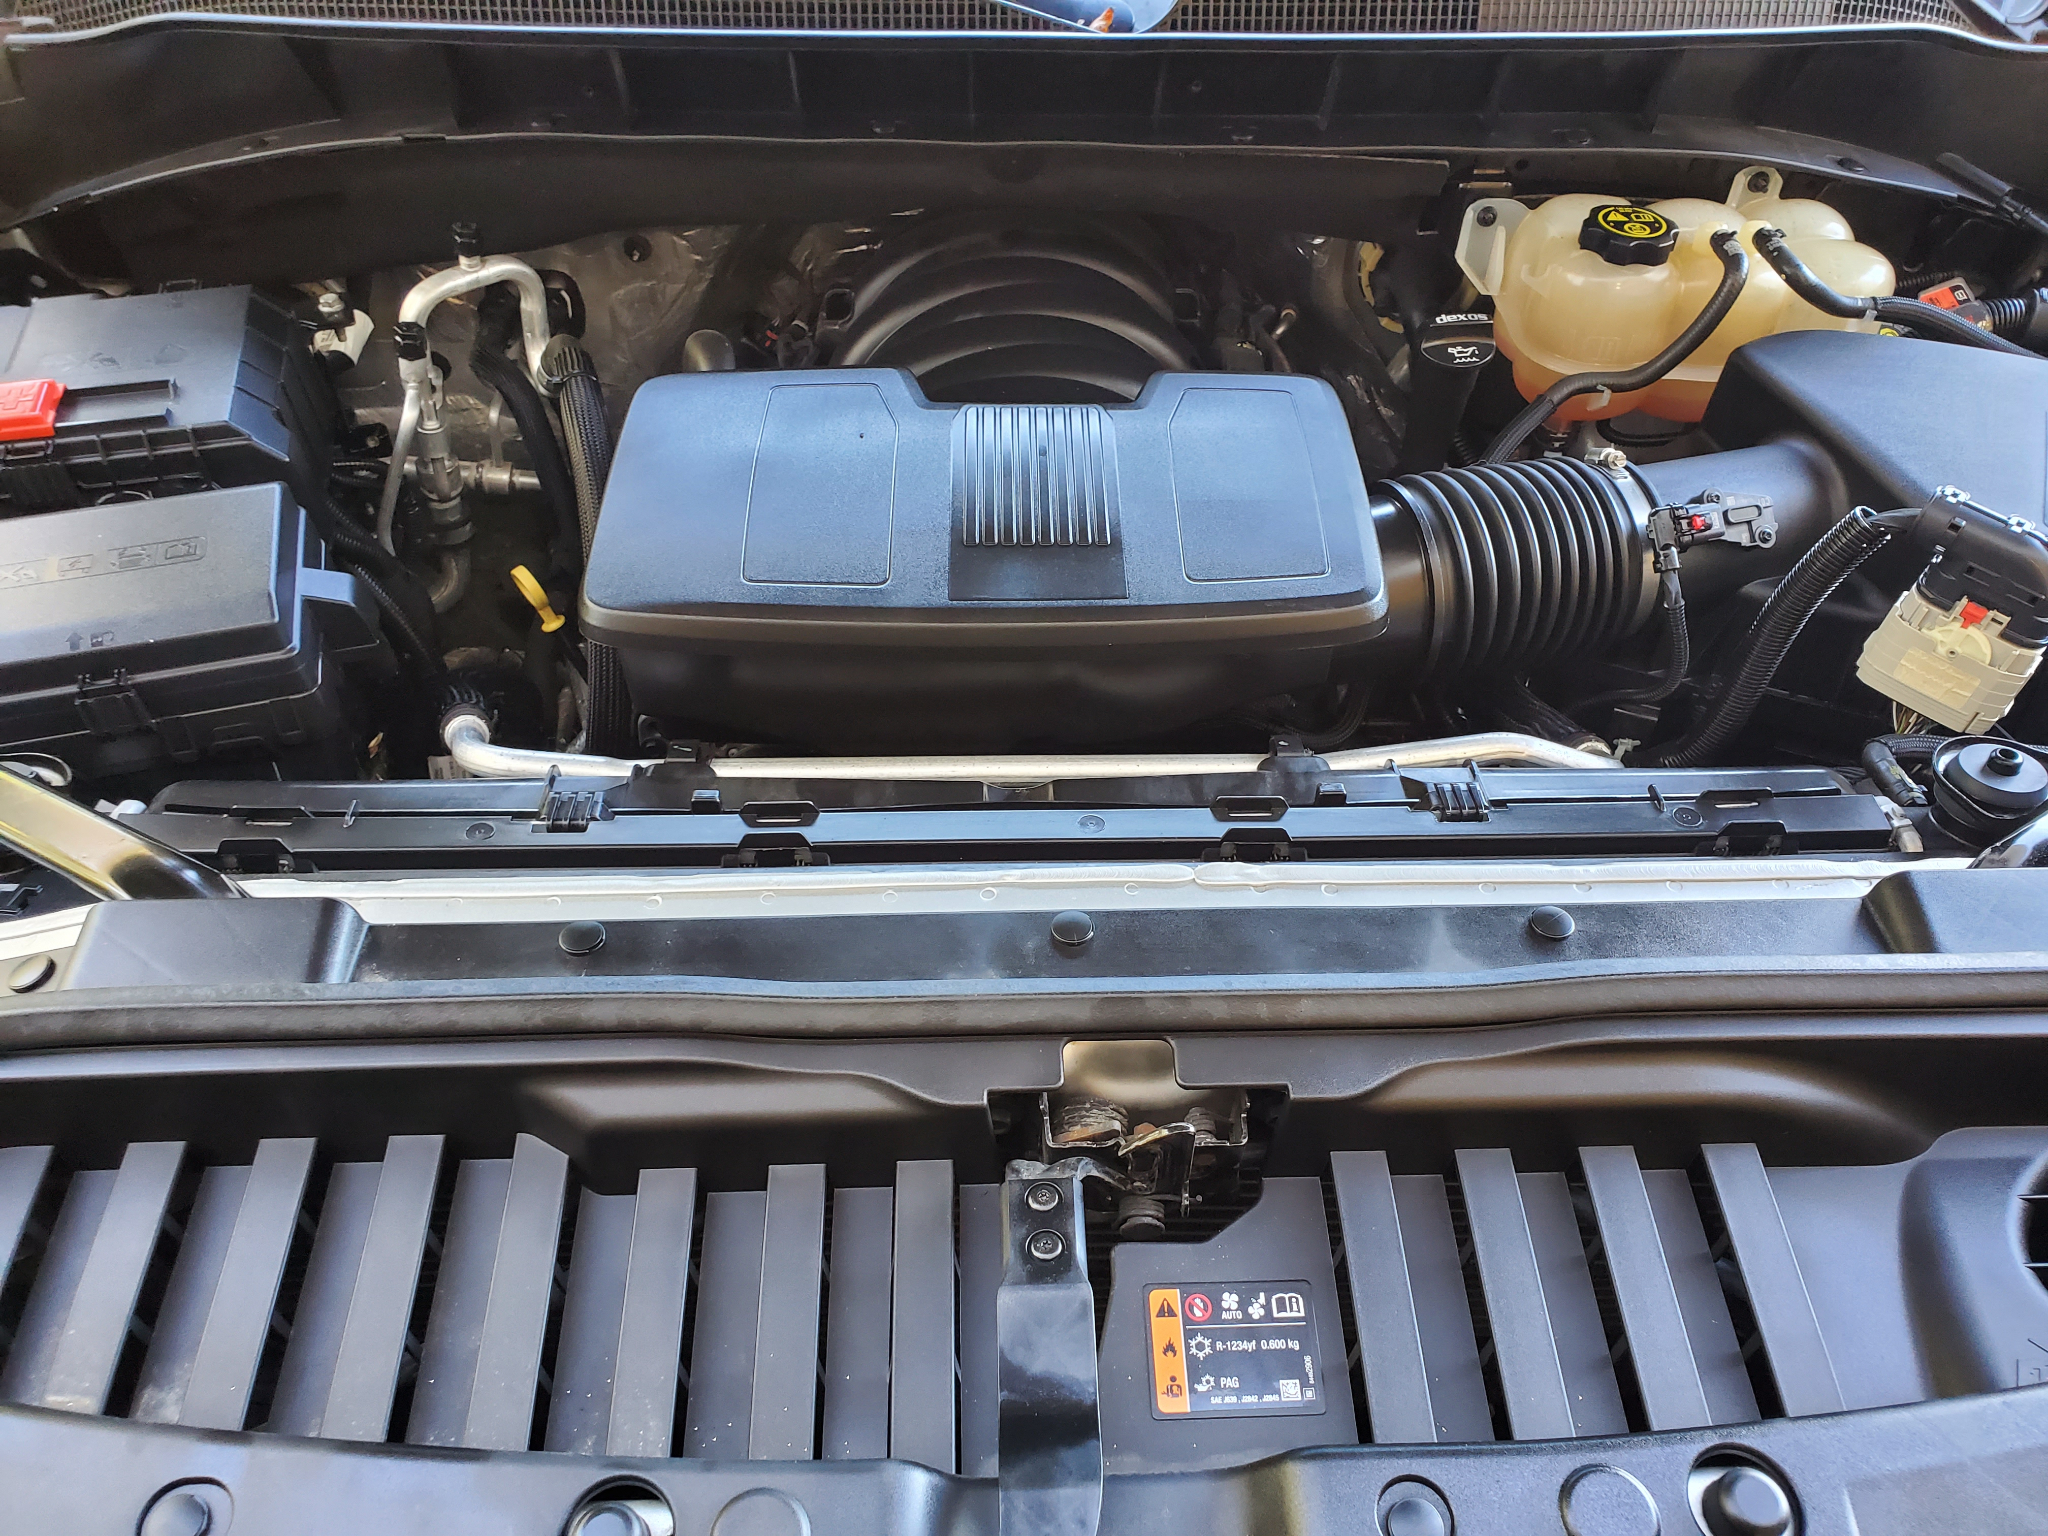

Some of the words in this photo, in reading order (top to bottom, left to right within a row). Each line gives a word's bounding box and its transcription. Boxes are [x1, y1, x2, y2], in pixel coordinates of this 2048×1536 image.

[1435, 313, 1489, 324] dexos
[1221, 1310, 1243, 1320] AUTO
[1216, 1340, 1256, 1353] R-1234yf
[1260, 1339, 1287, 1350] 0.600
[1287, 1338, 1300, 1351] kg
[1220, 1377, 1240, 1389] PAG
[1210, 1396, 1223, 1404] SAE
